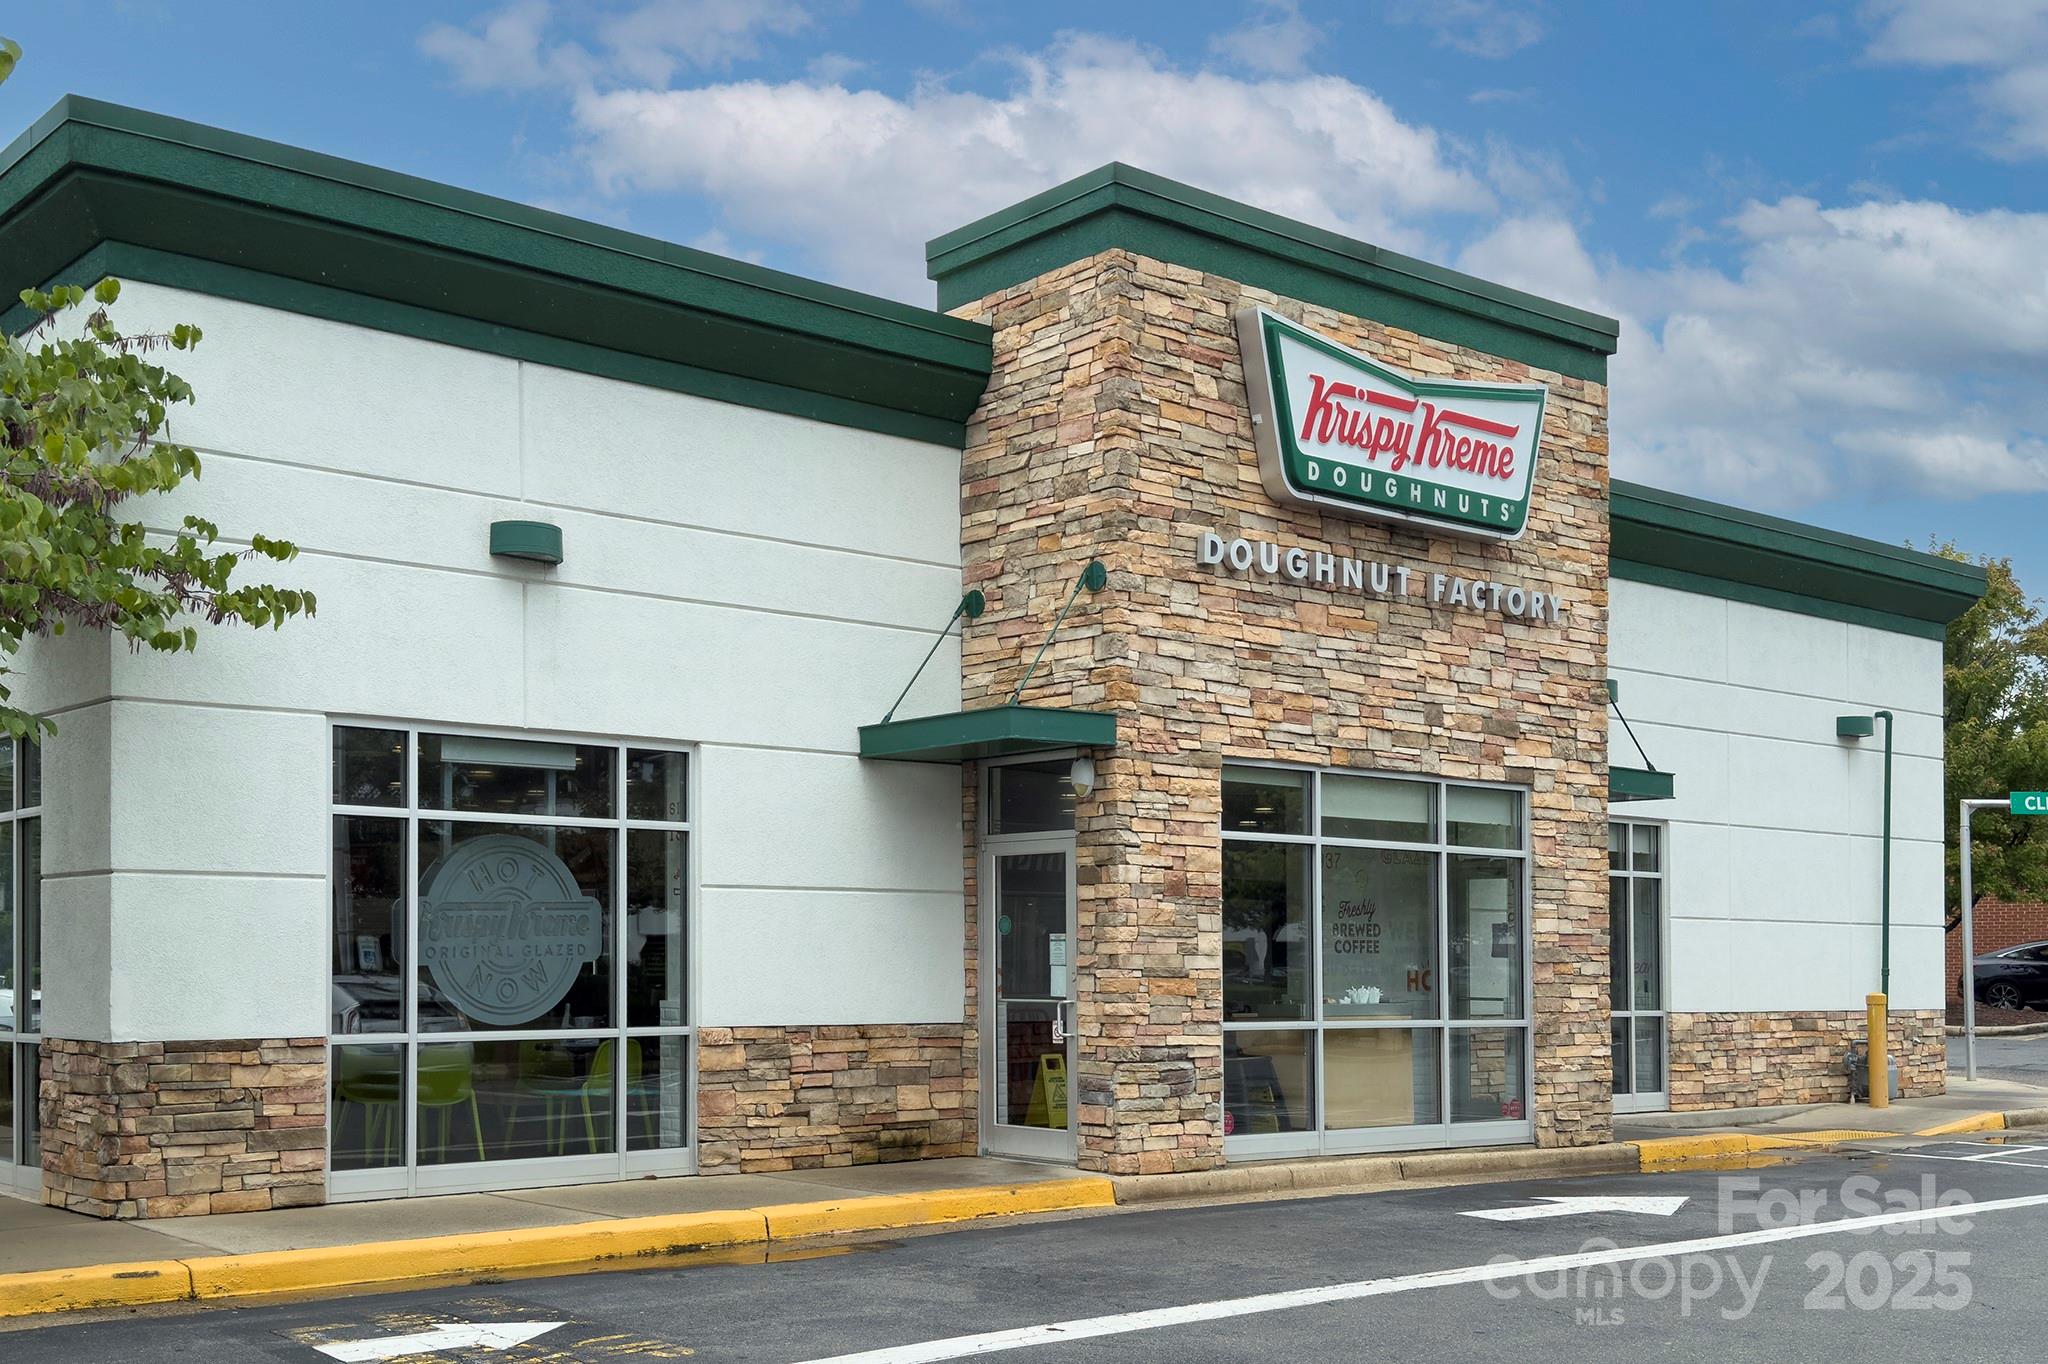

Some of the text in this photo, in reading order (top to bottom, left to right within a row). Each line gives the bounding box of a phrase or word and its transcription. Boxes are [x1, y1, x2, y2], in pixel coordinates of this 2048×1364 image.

[1300, 373, 1520, 480] Krispy Kreme
[1201, 532, 1563, 622] DOUGHNUT FACTORY
[2024, 796, 2048, 811] CL
[466, 856, 546, 894] HOT
[1338, 899, 1377, 922] Freshly
[1332, 923, 1381, 938] BREWED
[425, 943, 587, 960] ORIGINAL GLAZED
[1334, 939, 1380, 954] COFFEE
[466, 959, 550, 1003] NOW
